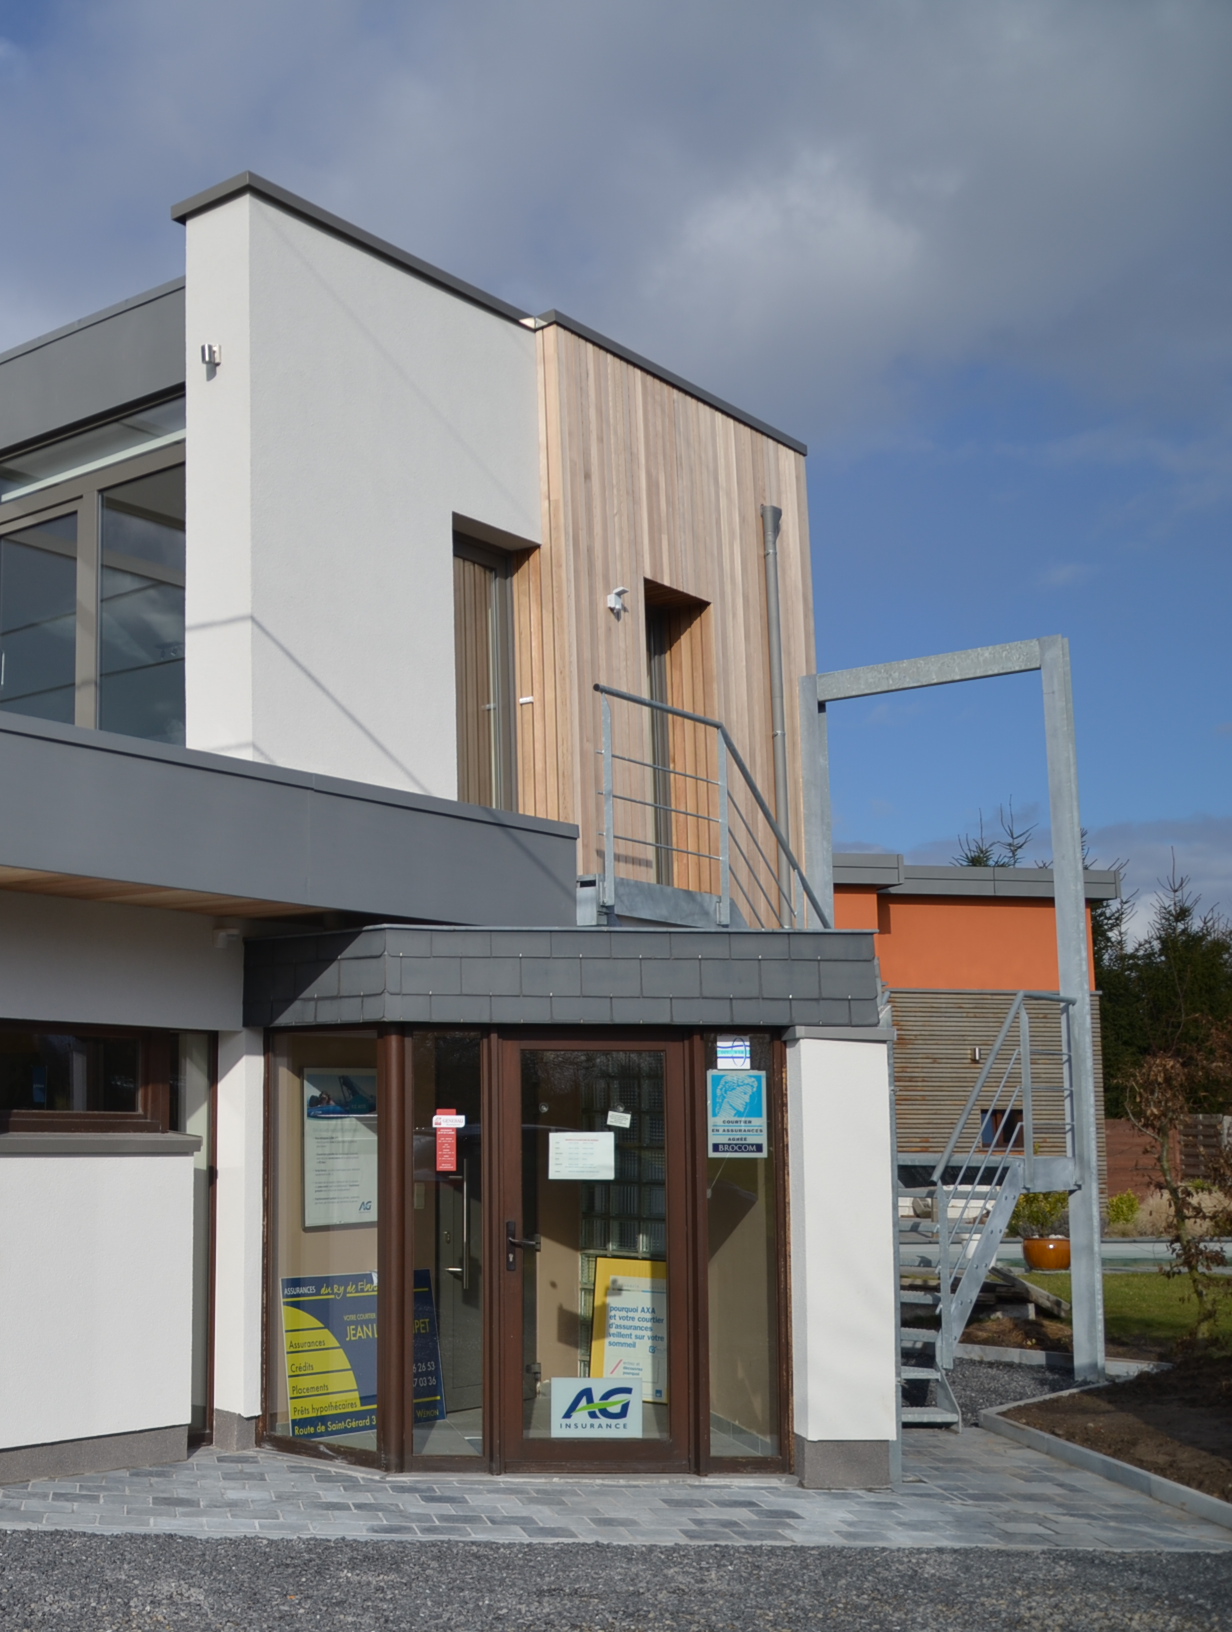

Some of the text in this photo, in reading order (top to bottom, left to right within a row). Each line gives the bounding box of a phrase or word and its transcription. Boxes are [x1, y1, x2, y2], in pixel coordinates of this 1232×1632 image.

[718, 1144, 757, 1152] BROCOM
[358, 1200, 372, 1211] AG
[284, 1286, 316, 1295] ASSURANCES
[321, 1283, 332, 1294] du
[333, 1284, 344, 1300] Ry
[346, 1282, 356, 1293] de
[609, 1305, 656, 1314] pourquoi AXA
[637, 1315, 664, 1324] courtier
[346, 1324, 373, 1341] JEAN
[609, 1322, 654, 1332] d'assurances
[608, 1331, 633, 1340] veillent
[647, 1334, 665, 1342] votre
[289, 1340, 326, 1349] Assurances
[608, 1340, 636, 1348] sommeil
[290, 1362, 314, 1373] Crédits
[417, 1362, 426, 1372] 26
[427, 1361, 435, 1371] 53
[418, 1377, 427, 1387] 03
[428, 1376, 436, 1386] 36
[291, 1384, 329, 1395] Placements
[293, 1401, 357, 1416] Prêts hypothécaires
[561, 1387, 633, 1420] AG
[294, 1425, 315, 1436] Route
[316, 1422, 326, 1432] de
[327, 1415, 370, 1431] Saint-Gérard
